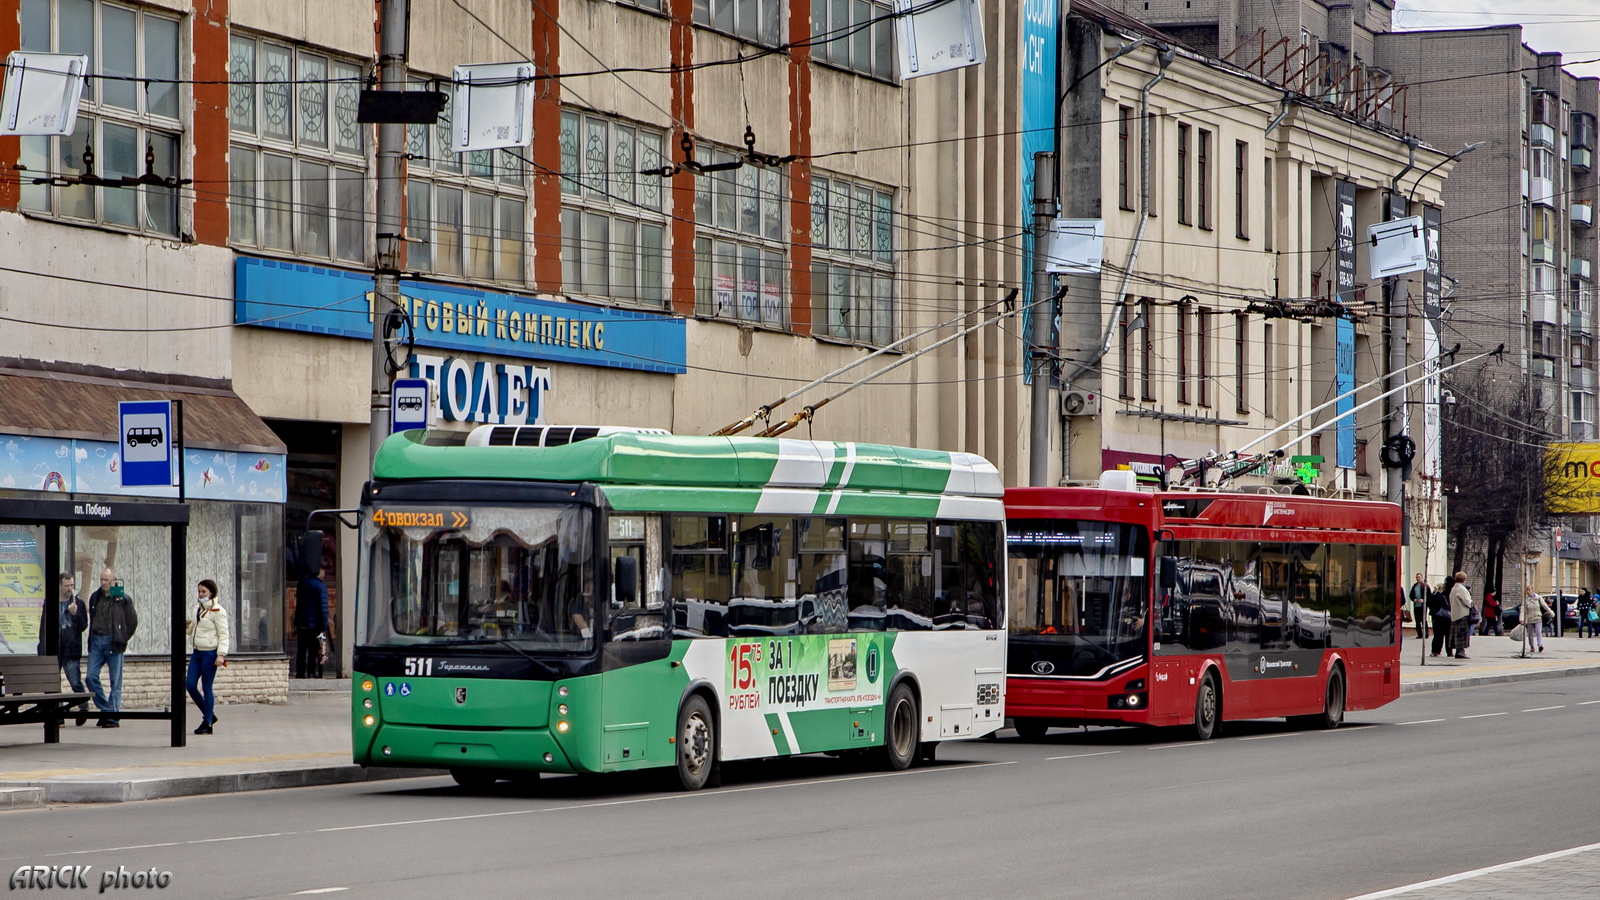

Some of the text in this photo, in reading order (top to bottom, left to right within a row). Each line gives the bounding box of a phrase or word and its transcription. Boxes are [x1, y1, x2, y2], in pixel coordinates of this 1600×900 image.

[1030, 33, 1045, 75] СНГ
[365, 291, 604, 350] ТРГОВЫЙ КОМПЛЕКС
[412, 353, 551, 425] ПОЛЕТ
[74, 503, 112, 518] пл. Победы
[619, 518, 632, 537] 511
[405, 657, 433, 676] 511
[769, 641, 793, 670] ЗА 1
[729, 691, 760, 710] РУБЛЕЙ
[768, 674, 819, 707] ПОЕЗДКУ
